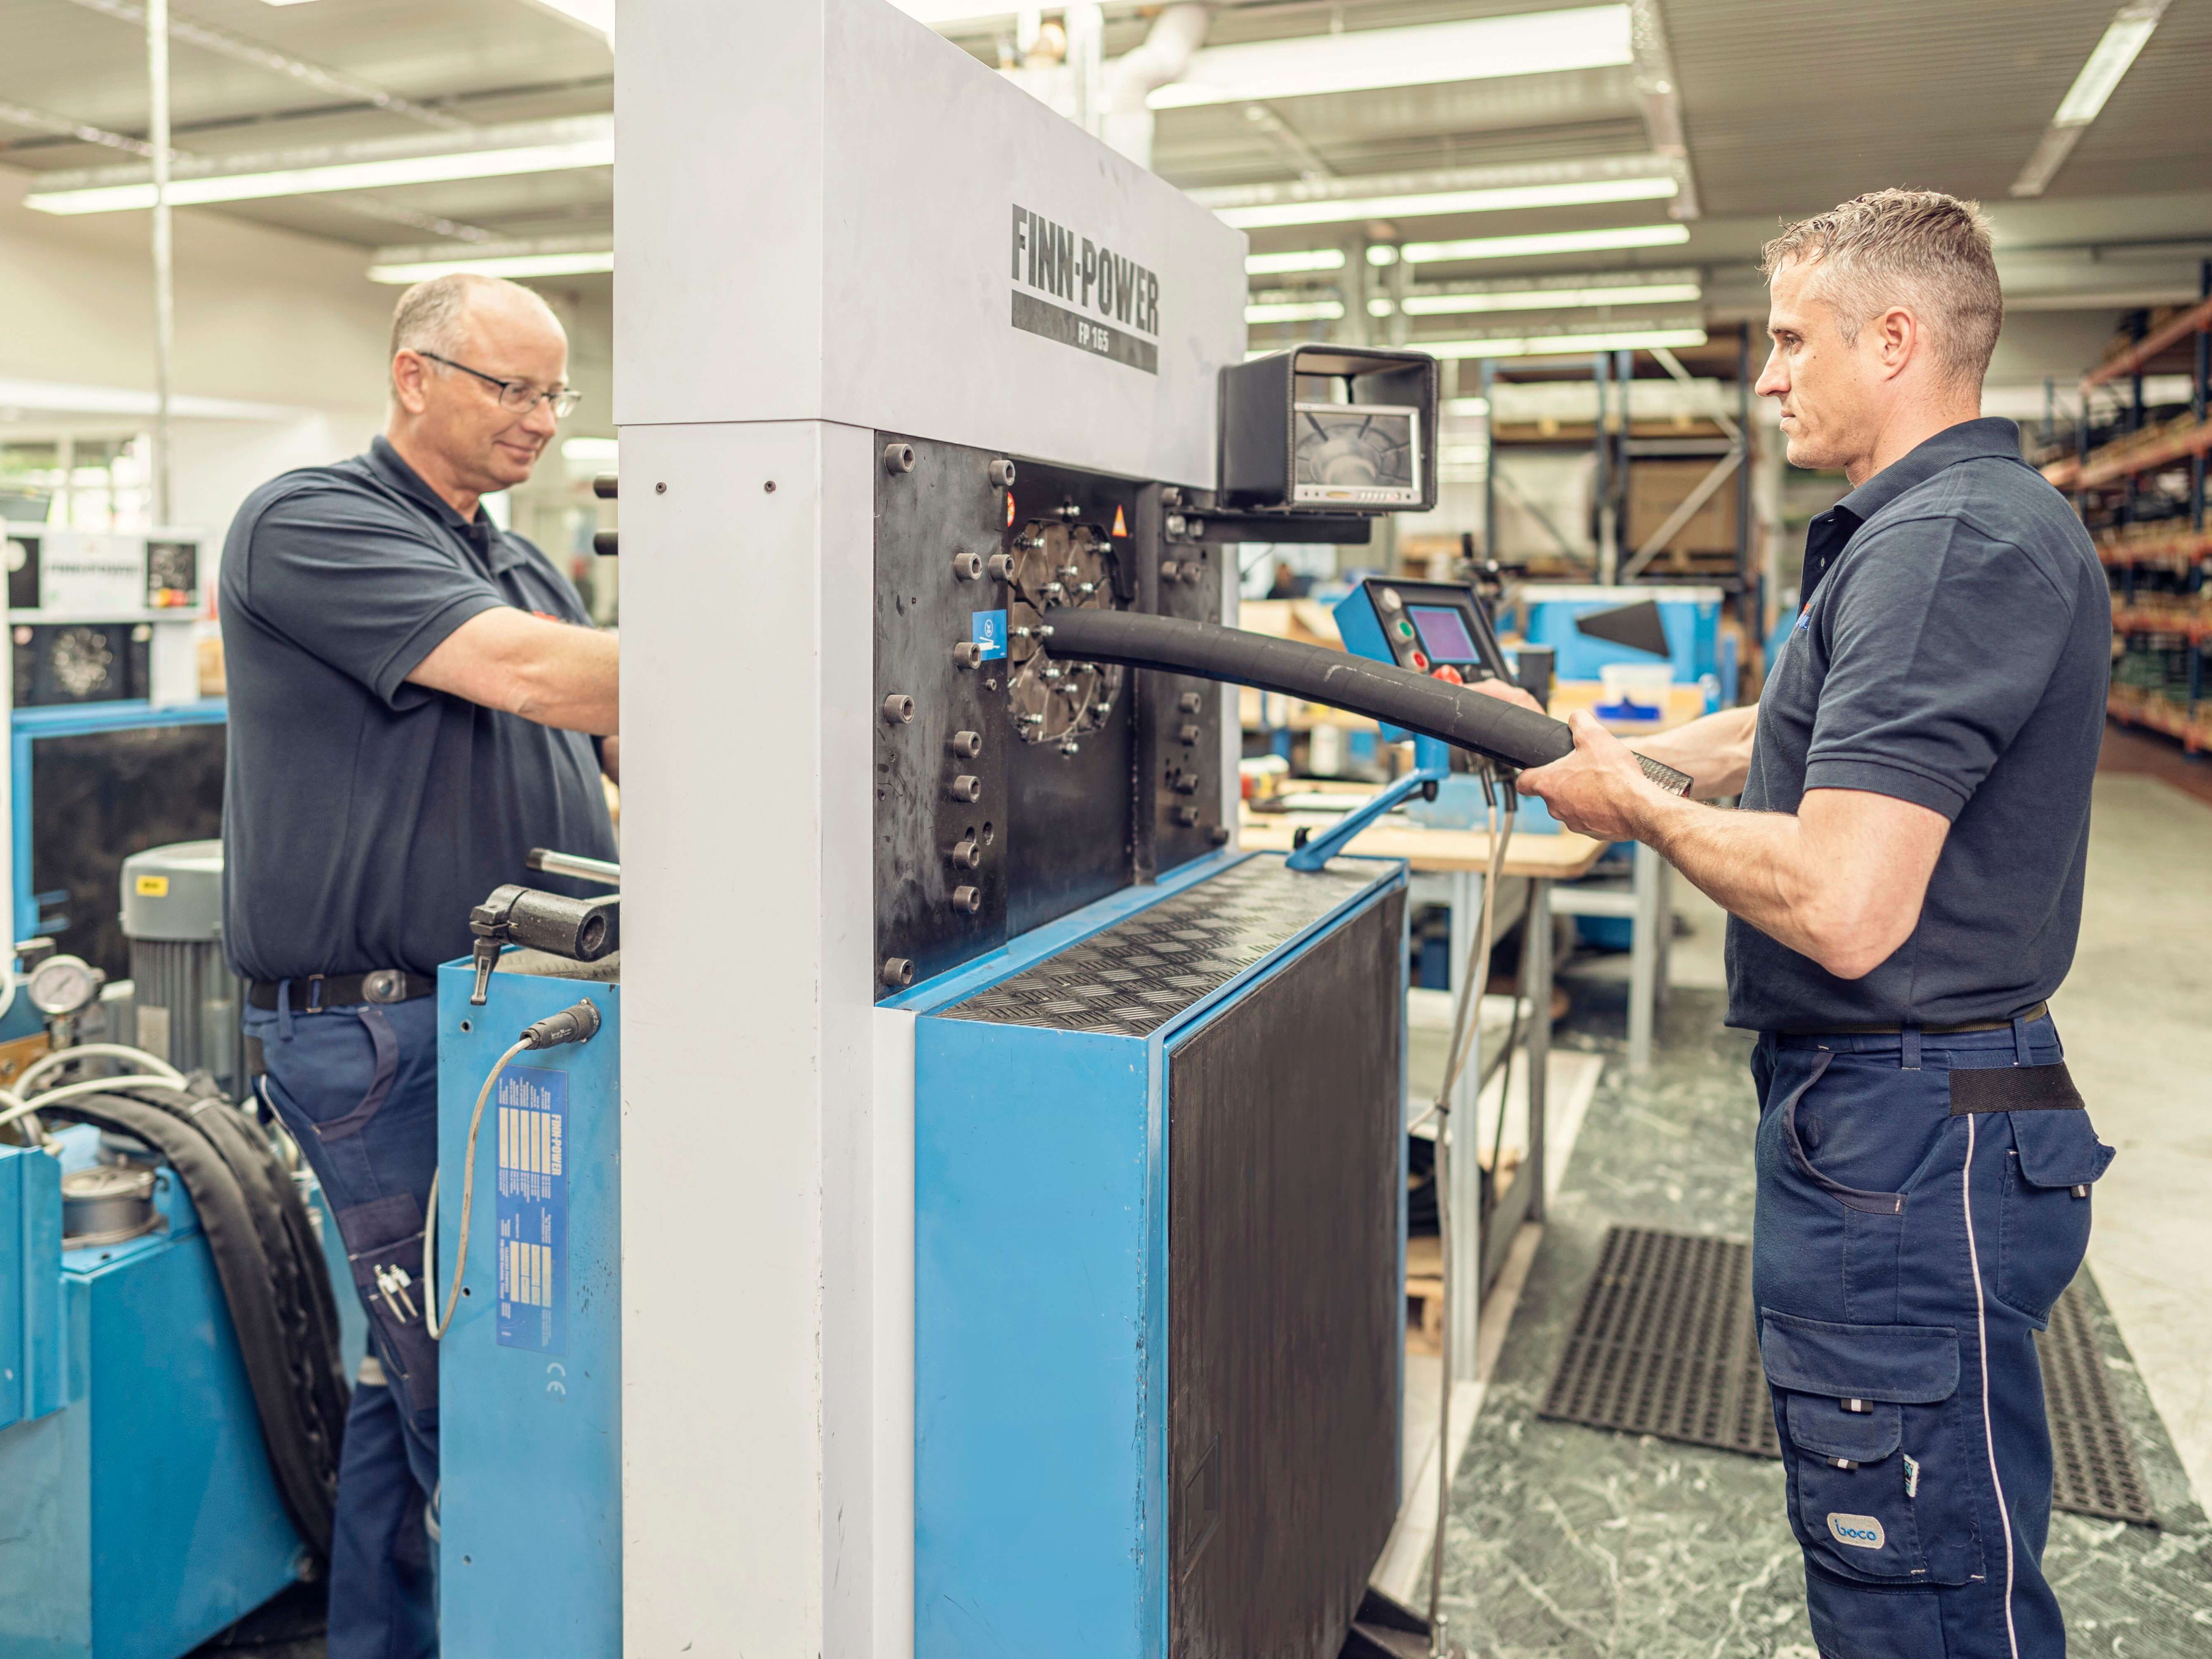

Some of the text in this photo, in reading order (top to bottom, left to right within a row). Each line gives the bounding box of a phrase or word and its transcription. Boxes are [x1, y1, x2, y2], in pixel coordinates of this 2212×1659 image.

[1011, 203, 1159, 337] FINN-POWER
[1079, 321, 1109, 352] FP 165
[552, 1114, 562, 1176] FINN-POWER
[547, 1362, 566, 1395] CE
[1835, 1519, 1877, 1540] boco
